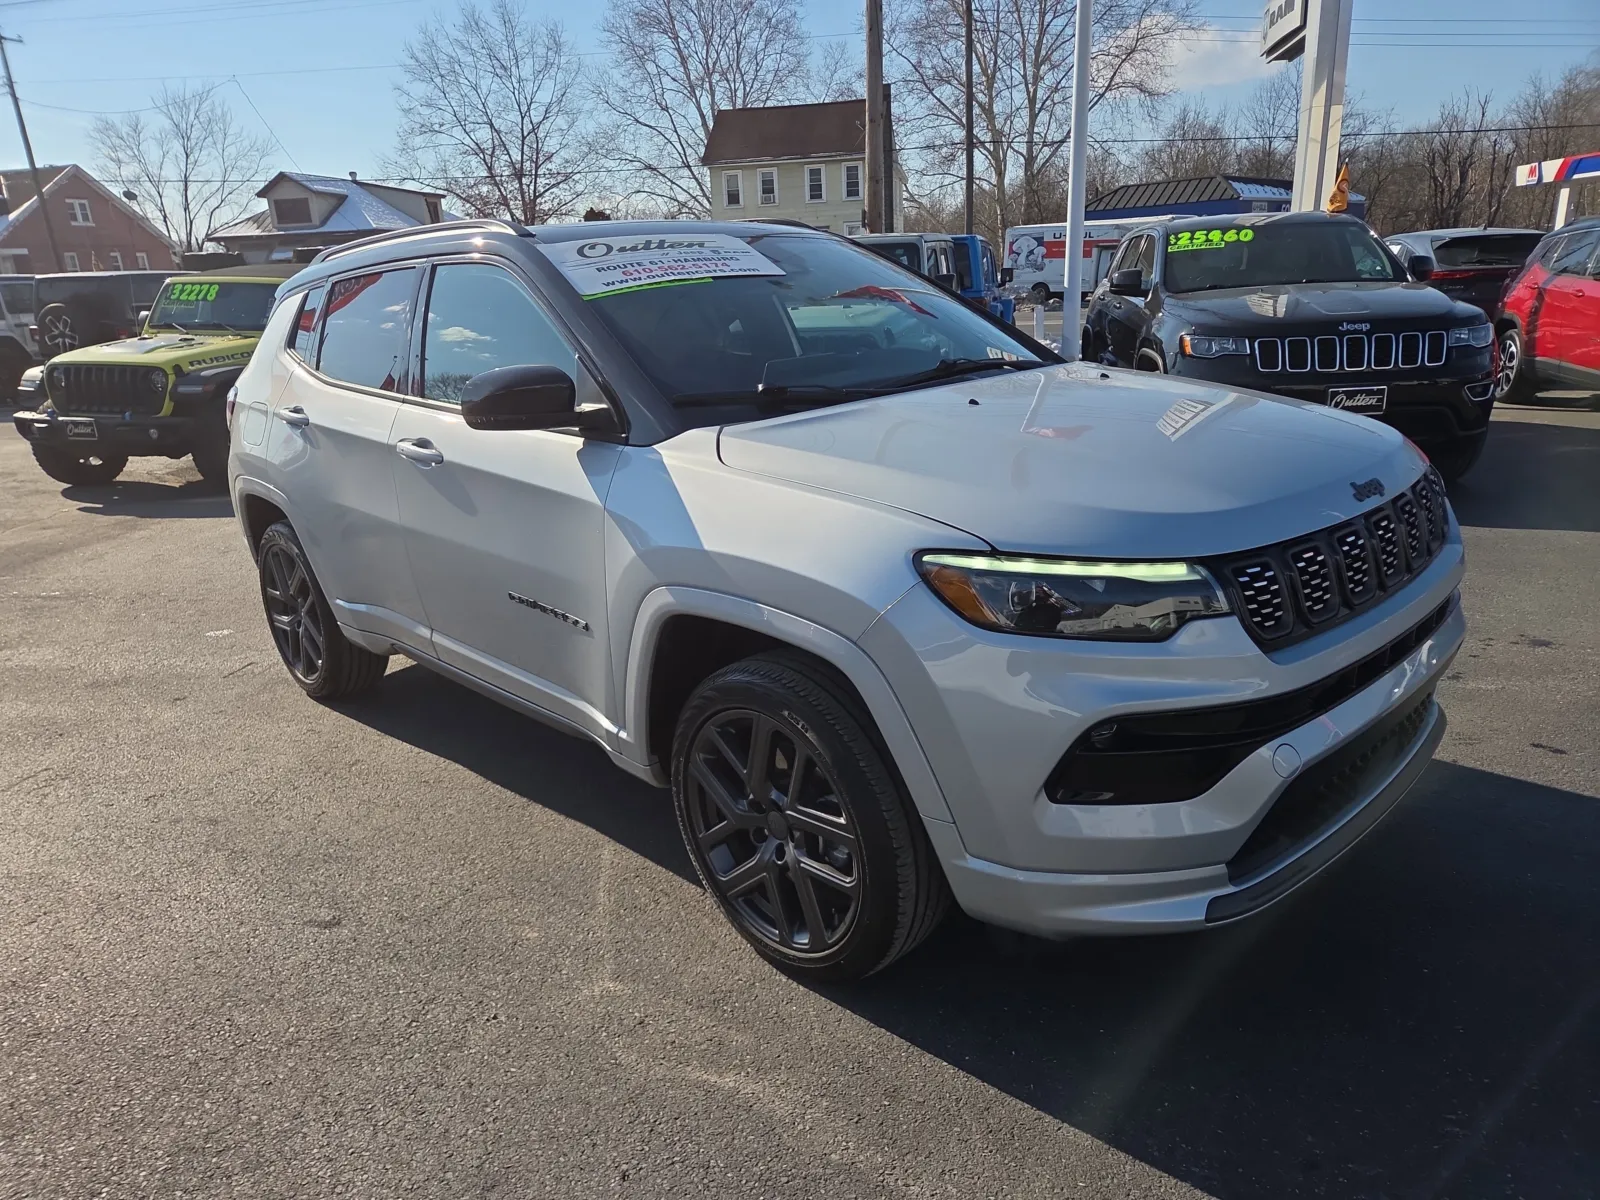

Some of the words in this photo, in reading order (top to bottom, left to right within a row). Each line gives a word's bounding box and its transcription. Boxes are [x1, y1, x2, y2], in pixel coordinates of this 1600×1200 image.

[576, 239, 724, 258] Outten
[1169, 242, 1223, 251] CERTIFIED
[595, 261, 646, 273] ROUTE
[621, 262, 731, 277] 610-562-5174
[601, 267, 760, 287] www.outtencars.com
[1339, 322, 1371, 331] Jeep
[1331, 393, 1383, 409] Outten
